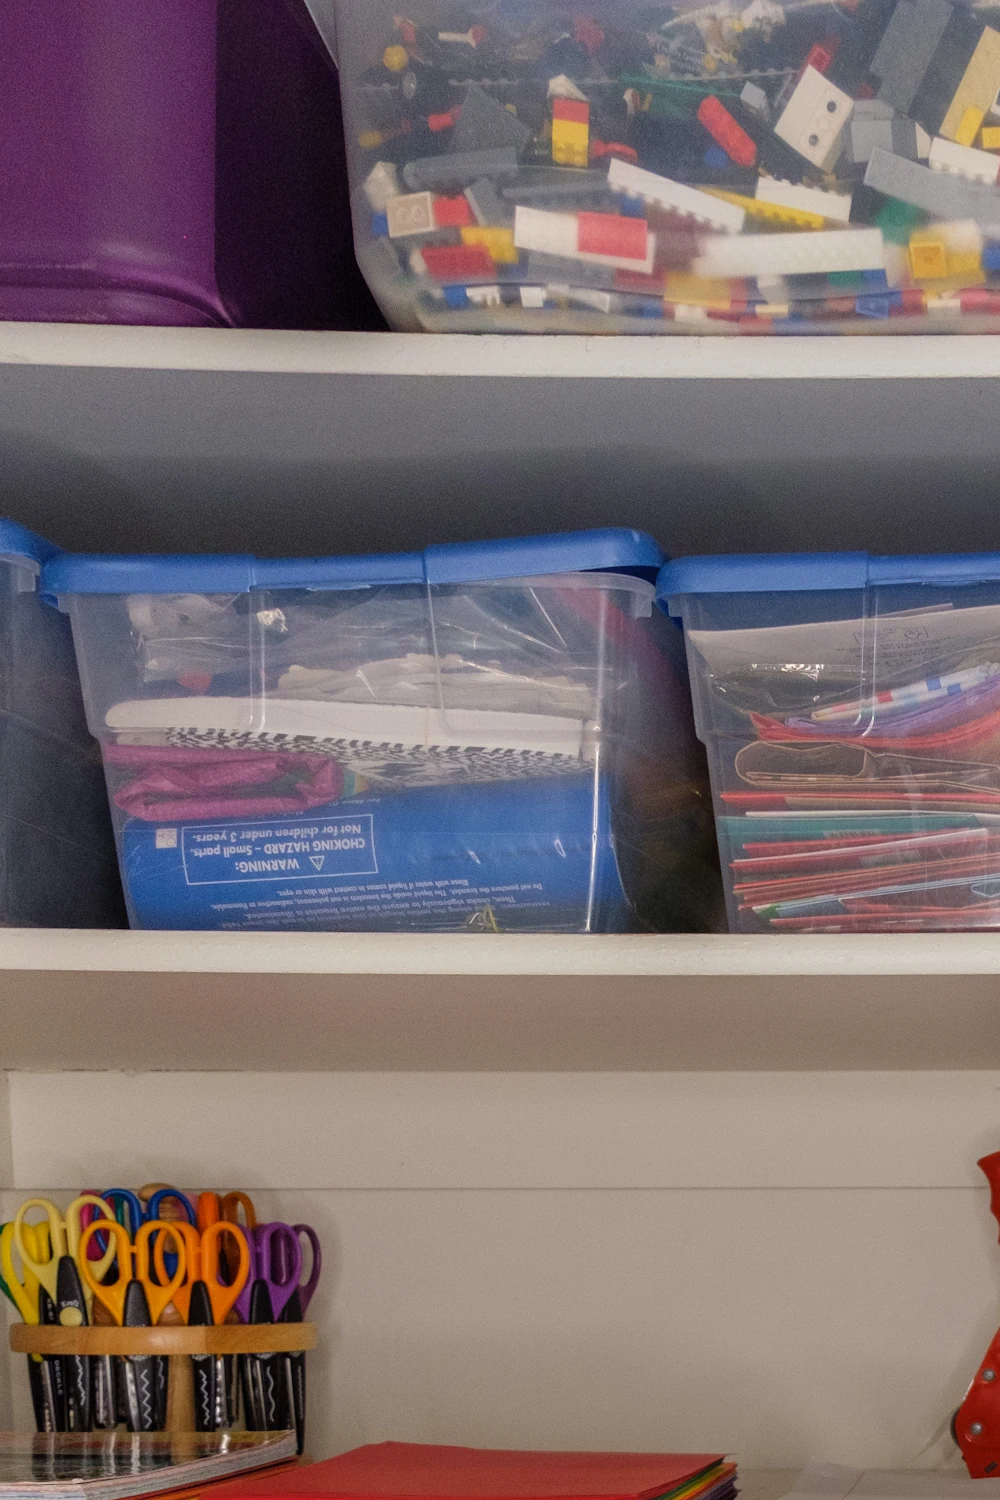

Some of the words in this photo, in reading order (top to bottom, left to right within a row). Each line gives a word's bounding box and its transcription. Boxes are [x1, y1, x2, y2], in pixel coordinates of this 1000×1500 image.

[240, 829, 272, 838] under
[275, 827, 318, 837] children
[345, 824, 361, 834] Not
[264, 842, 309, 854] HAZARD
[312, 838, 365, 850] CHOKING
[191, 846, 220, 857] parts.
[225, 845, 252, 857] Small
[236, 859, 299, 872] WARNING:
